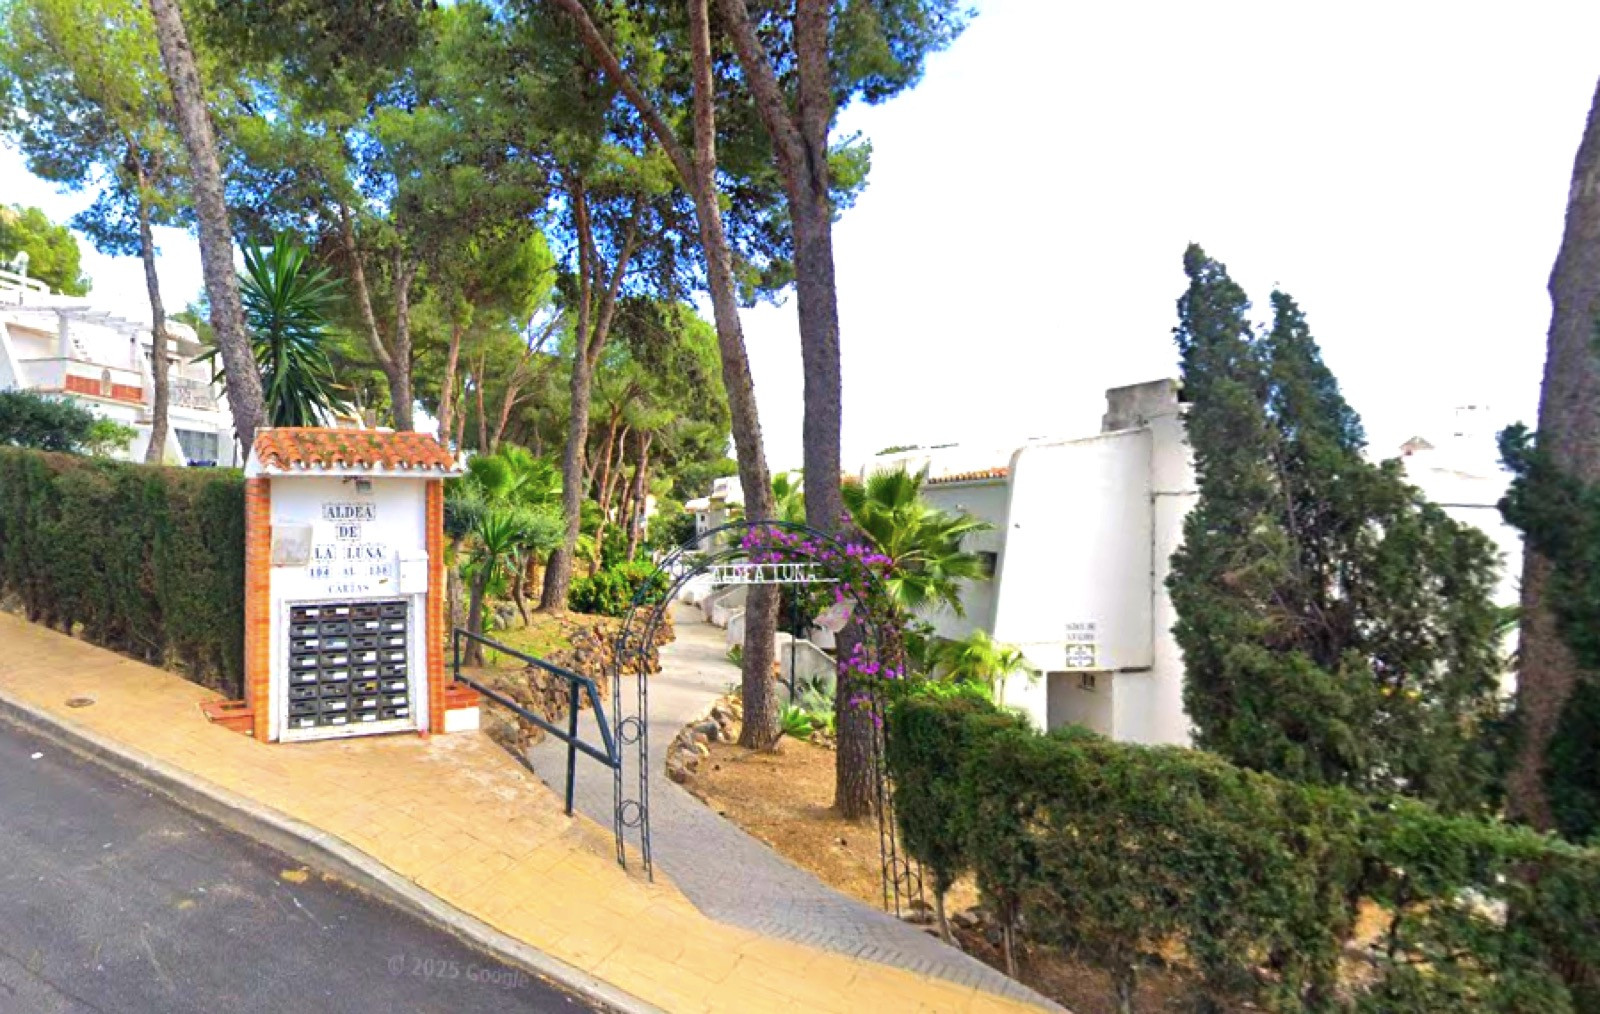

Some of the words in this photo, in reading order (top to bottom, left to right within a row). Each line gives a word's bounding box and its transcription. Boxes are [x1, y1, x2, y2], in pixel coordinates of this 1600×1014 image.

[327, 506, 373, 519] ALDEA
[340, 526, 357, 538] DE
[315, 547, 333, 559] LA
[347, 547, 383, 559] LUNA
[774, 564, 816, 581] LUNA
